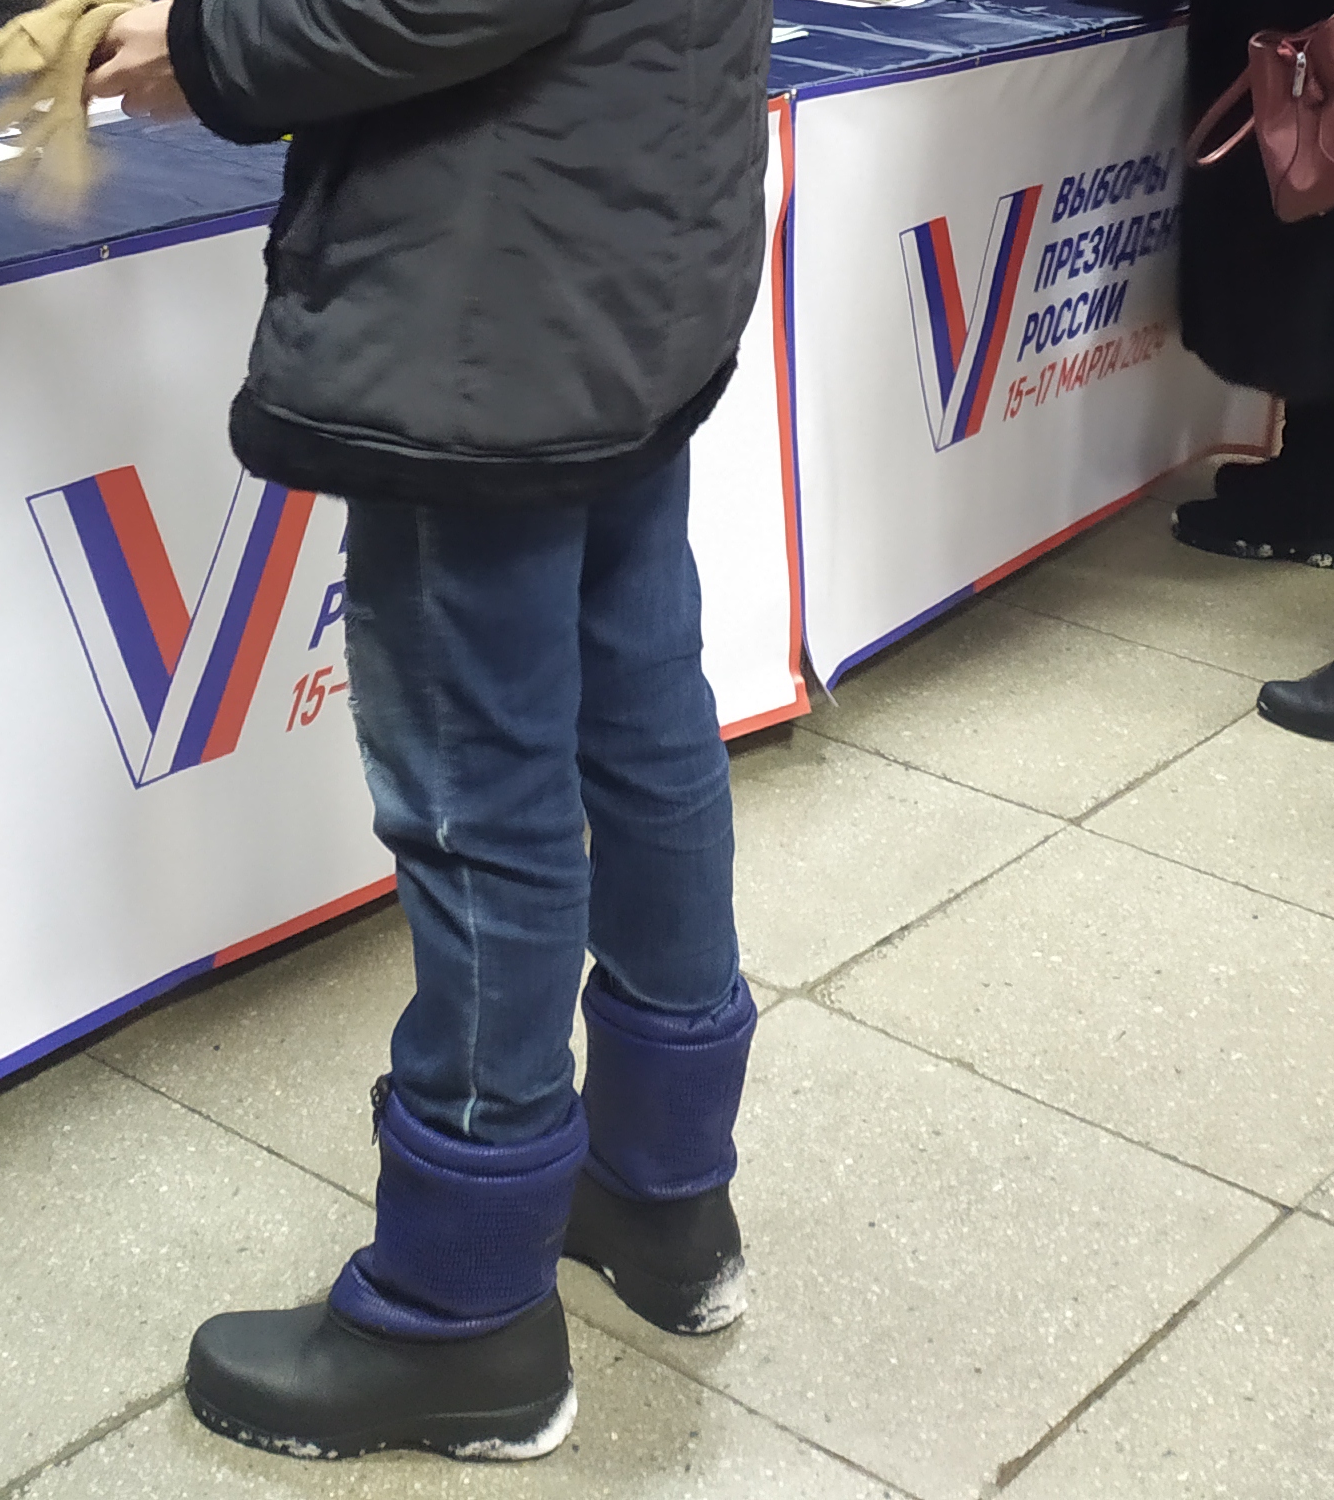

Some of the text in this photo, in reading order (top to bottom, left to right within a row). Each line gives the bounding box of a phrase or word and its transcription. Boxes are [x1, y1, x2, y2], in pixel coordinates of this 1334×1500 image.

[1051, 147, 1176, 224] ВЫБОРЫ
[1034, 204, 1181, 293] ПРЕЗИДЕН
[1017, 279, 1129, 362] РОССИИ
[1056, 338, 1124, 398] МАРТА
[285, 665, 349, 733] 15-
